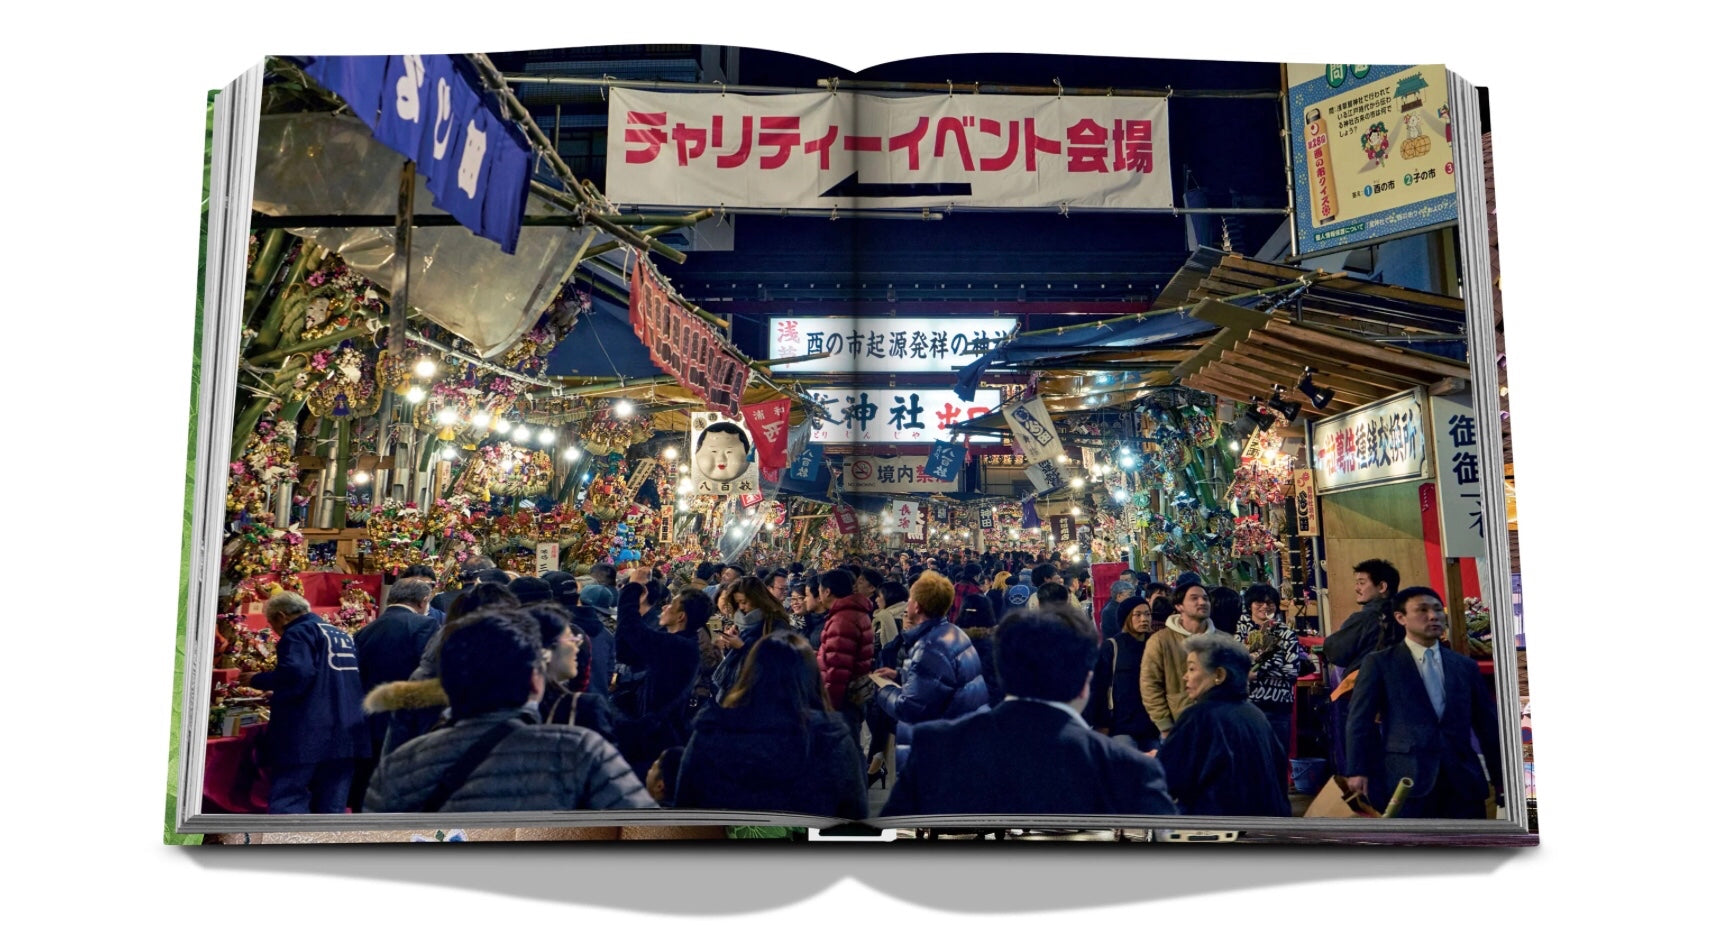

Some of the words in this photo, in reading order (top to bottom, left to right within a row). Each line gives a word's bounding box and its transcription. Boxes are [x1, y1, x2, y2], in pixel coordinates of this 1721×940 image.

[624, 110, 1154, 174] チャリティーイベント会場
[1373, 180, 1396, 195] 酉の市
[1413, 168, 1437, 184] 子の市
